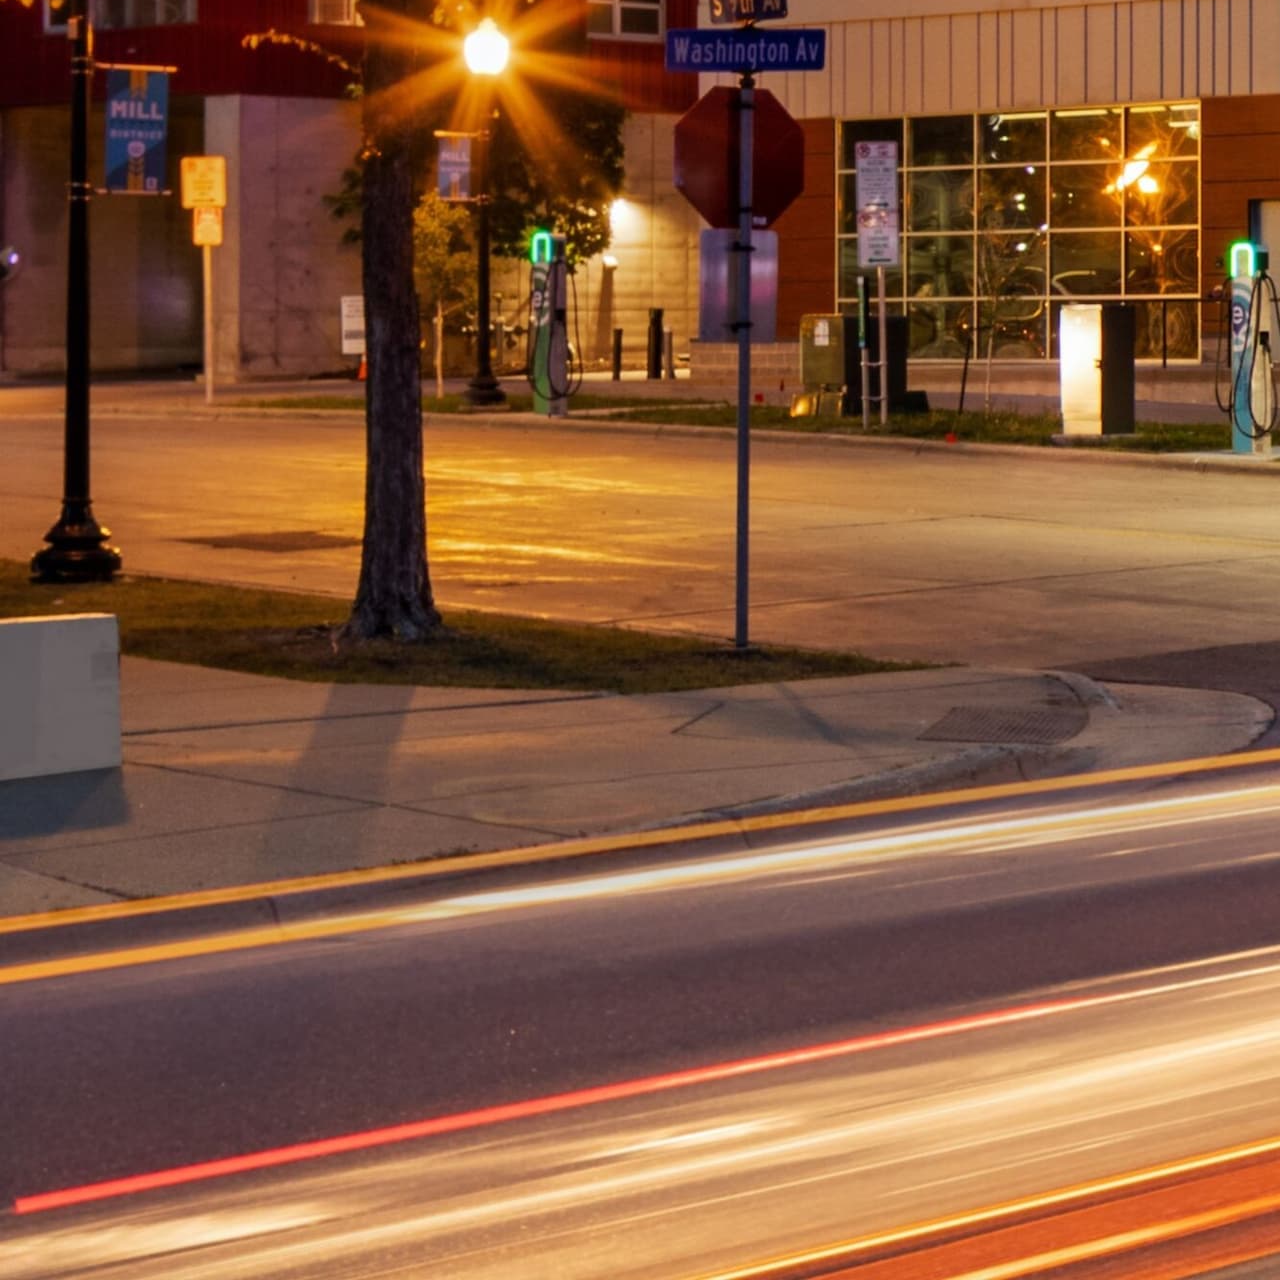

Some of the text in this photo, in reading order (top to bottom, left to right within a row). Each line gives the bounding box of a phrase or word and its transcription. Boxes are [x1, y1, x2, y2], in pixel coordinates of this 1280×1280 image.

[674, 37, 819, 69] Washington Av
[111, 100, 164, 120] MILL
